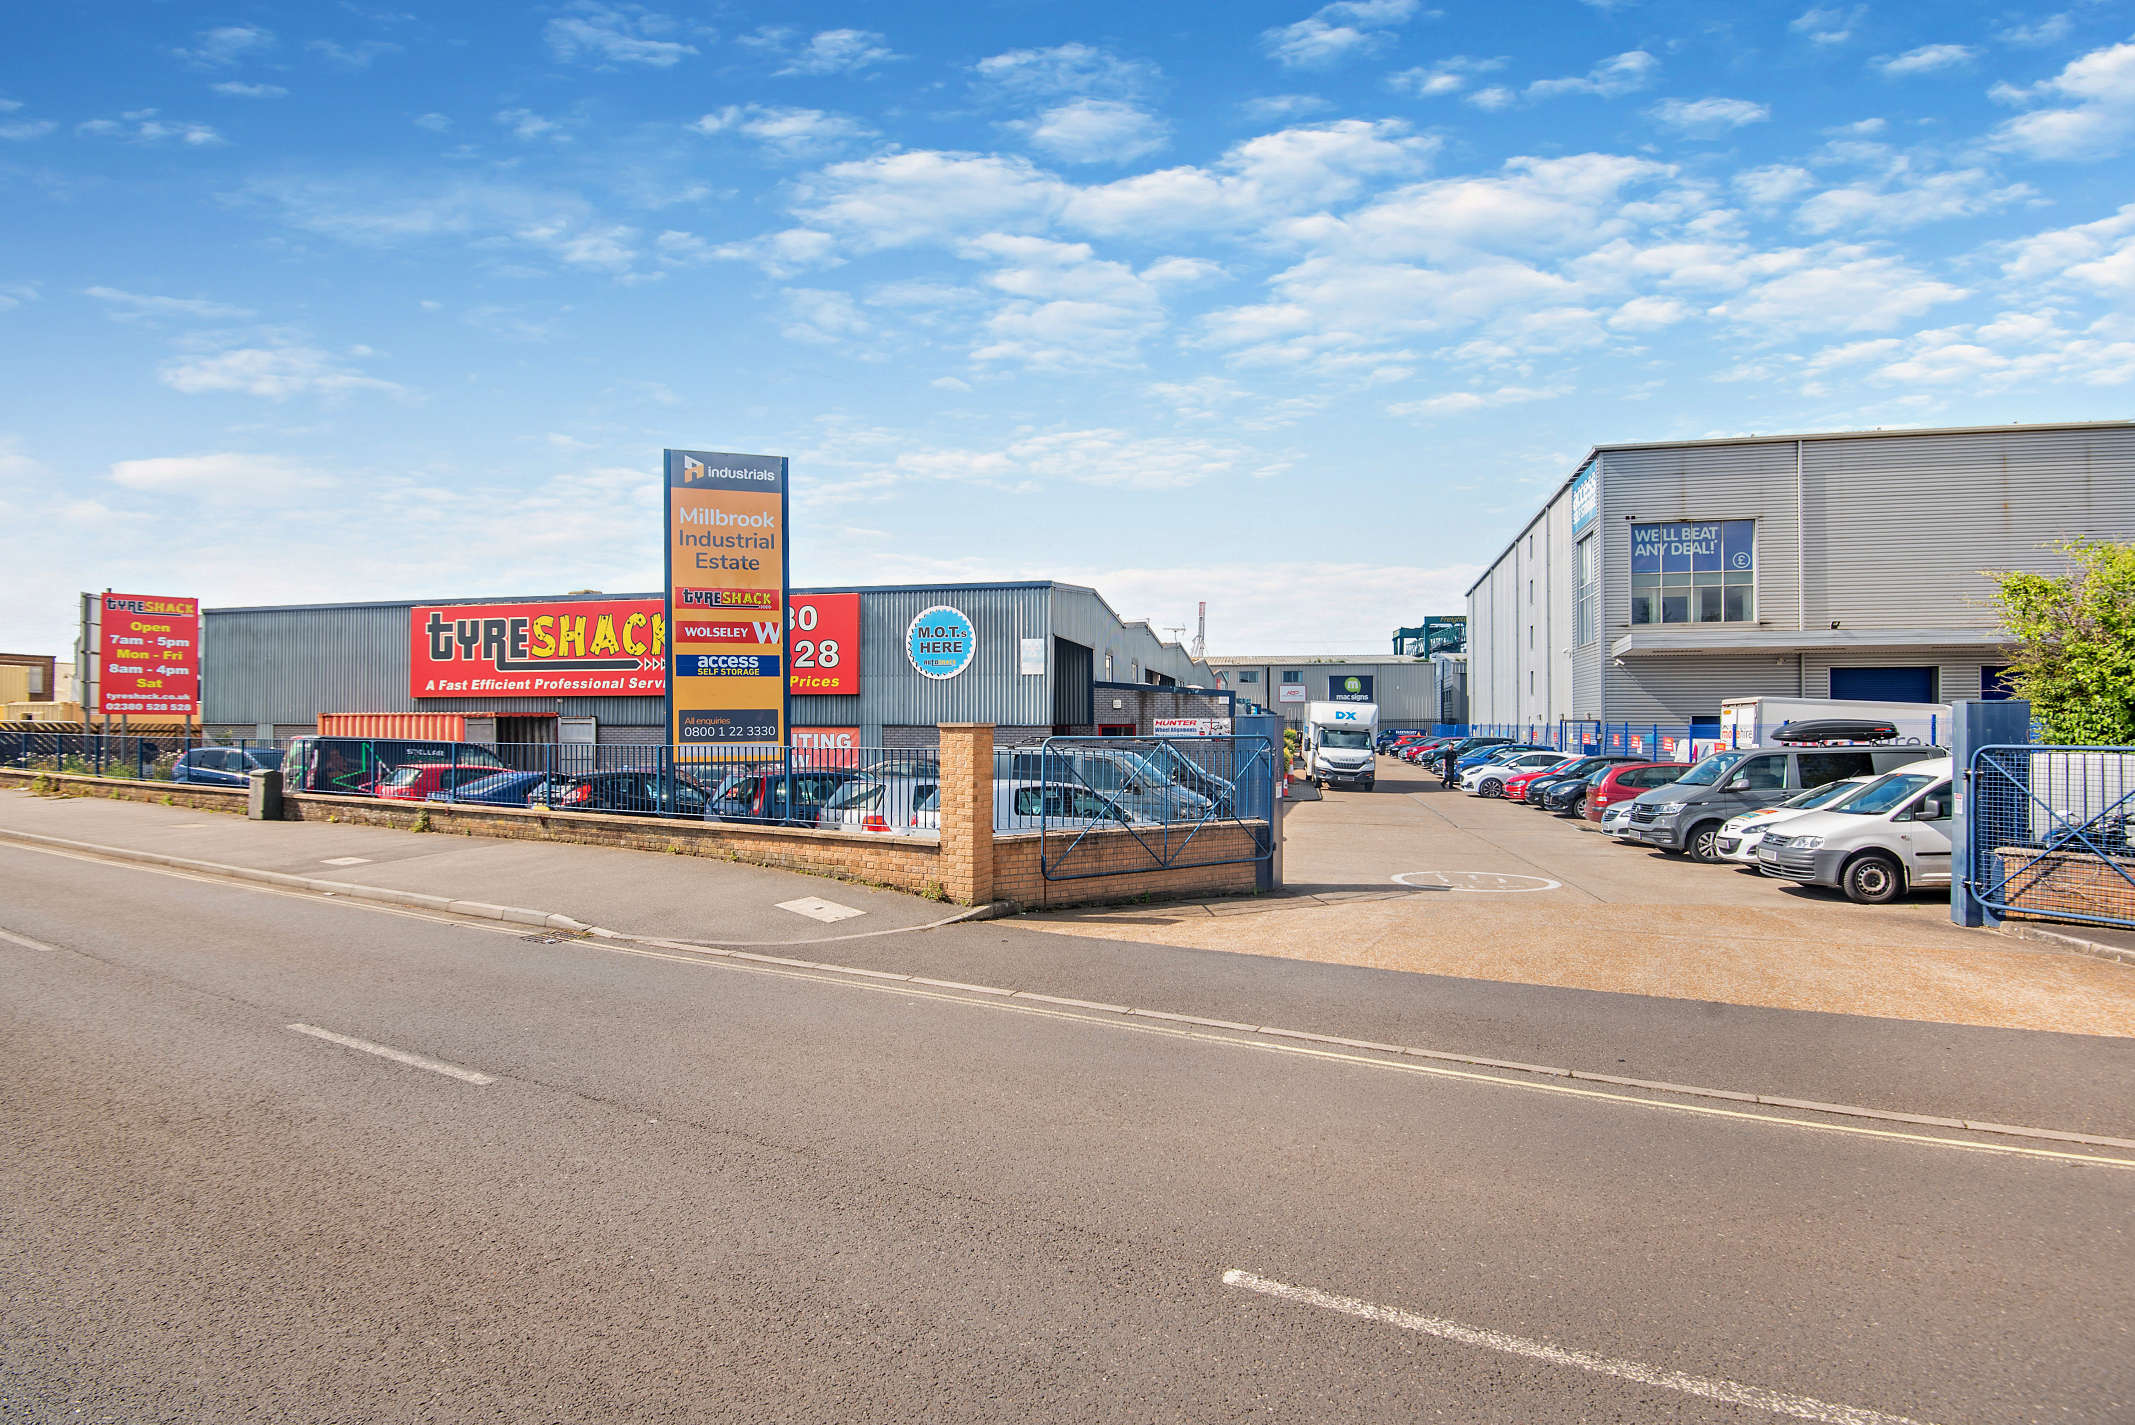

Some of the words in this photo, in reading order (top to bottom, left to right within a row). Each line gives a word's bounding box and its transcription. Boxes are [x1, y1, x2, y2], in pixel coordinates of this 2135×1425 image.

[708, 466, 775, 481] industrials
[679, 507, 775, 528] Millbrook
[679, 529, 775, 550] Industrial
[1634, 529, 1679, 542] WELL
[1681, 526, 1718, 540] BEAT
[1634, 543, 1668, 557] ANY
[696, 552, 760, 571] Estate
[130, 621, 171, 633] Open
[684, 627, 749, 638] WOLSELEY
[752, 621, 780, 644] W
[918, 626, 967, 638] M.O.T.s
[109, 634, 144, 645] 7am
[157, 636, 190, 648] 5pm
[920, 641, 963, 653] HERE
[116, 648, 150, 659] Mon
[163, 650, 183, 660] Fri
[697, 655, 759, 668] access
[109, 663, 143, 673] 8am
[156, 665, 189, 676] 4pm
[697, 668, 719, 676] SELF
[720, 668, 760, 676] STORAGE
[136, 678, 163, 688] Sat
[425, 679, 435, 691] A
[438, 679, 468, 691] Fast
[471, 678, 531, 690] Efficient
[534, 677, 625, 689] Professional
[790, 675, 840, 687] Prices
[1351, 693, 1369, 701] signs
[105, 702, 144, 711] 02380
[146, 703, 168, 711] 528
[170, 703, 192, 711] 528
[684, 716, 695, 725] All
[696, 716, 731, 725] enquiries
[1335, 711, 1357, 720] DX
[684, 726, 715, 737] 0800
[718, 726, 726, 737] 1
[729, 726, 744, 737] 22
[746, 726, 776, 736] 3330
